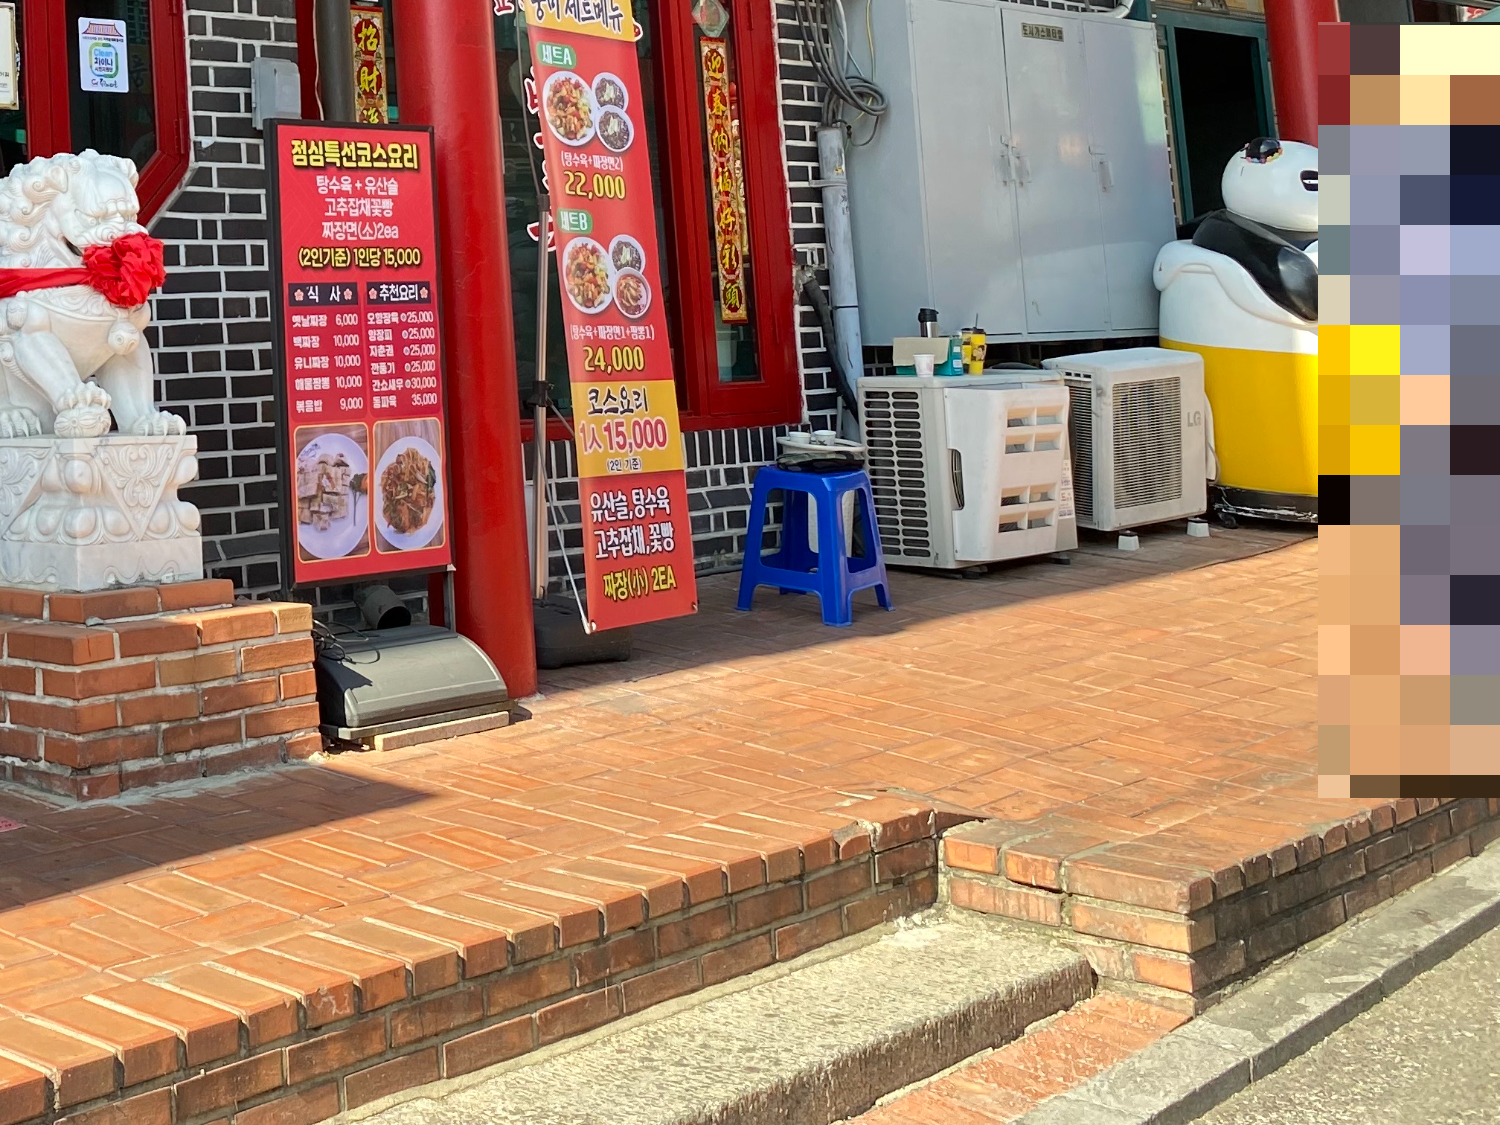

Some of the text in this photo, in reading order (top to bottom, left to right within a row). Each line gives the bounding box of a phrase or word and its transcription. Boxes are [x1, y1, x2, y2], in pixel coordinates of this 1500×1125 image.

[94, 57, 113, 66] 차이나
[541, 45, 573, 66] 세트A
[291, 139, 419, 170] 점심특선코스요리
[316, 175, 352, 194] 탕수육
[364, 176, 399, 195] 유산슬
[563, 171, 626, 199] 22,000
[324, 197, 393, 217] 고추잡채꽃빵
[559, 211, 589, 231] 세트B
[322, 221, 399, 241] 짜장면(소)2ea
[299, 248, 421, 268] (2인기준) 1인당 15,000
[379, 284, 419, 302] 추천요리
[335, 314, 358, 327] 6,000
[407, 311, 433, 324] 25,000
[333, 334, 359, 347] 10,000
[408, 327, 434, 340] 25,000
[409, 344, 435, 357] 25,000
[583, 346, 645, 373] 24,000
[334, 355, 361, 368] 10,000
[411, 360, 435, 373] 25,000
[335, 376, 362, 389] 10,000
[411, 377, 436, 390] 30,000
[296, 397, 363, 413] 볶음밥 9,000
[411, 393, 438, 406] 35,000
[587, 387, 649, 415] 코스요리
[1187, 410, 1201, 427] LG
[603, 418, 668, 454] 15,000
[590, 486, 671, 523] 유산슬,탕수육
[593, 521, 675, 559] 고추잡채,꽃빵
[603, 565, 677, 602] 짜장(小) 2EA
